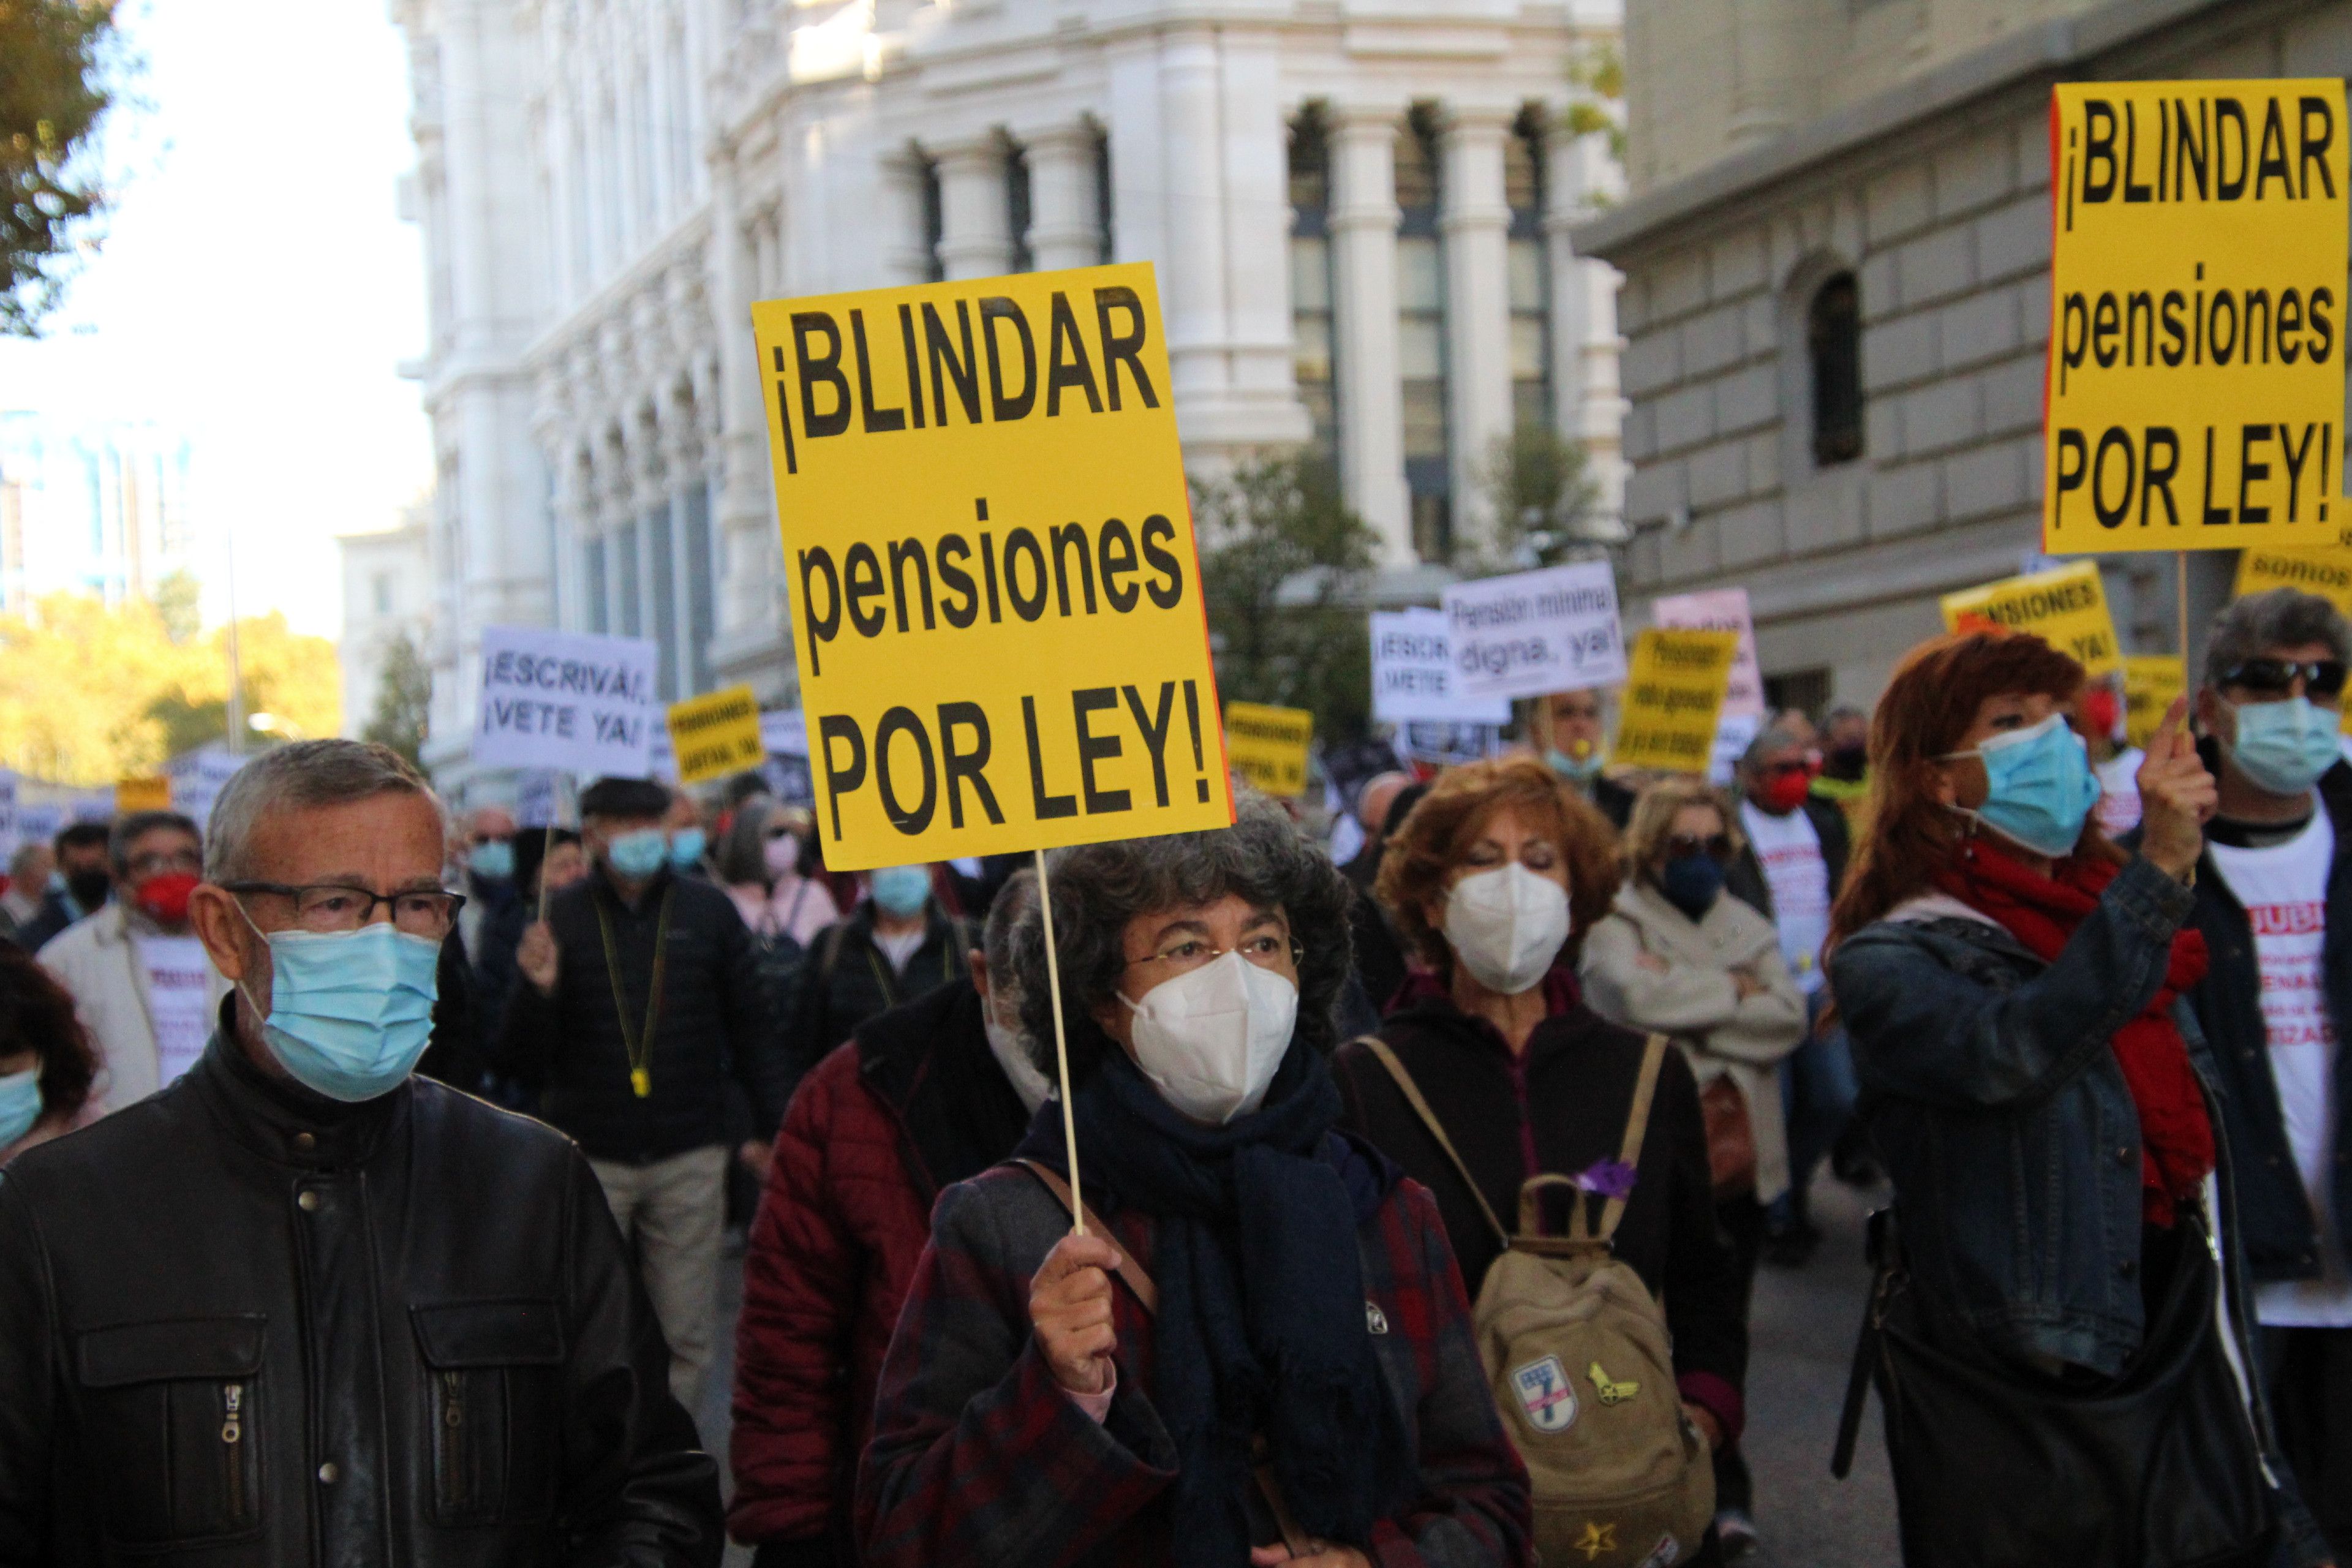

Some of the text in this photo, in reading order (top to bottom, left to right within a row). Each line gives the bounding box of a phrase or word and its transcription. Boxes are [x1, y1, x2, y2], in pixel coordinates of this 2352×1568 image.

[2065, 96, 2337, 232] ¡BLINDAR
[773, 285, 1161, 475] ¡BLINDAR
[2060, 262, 2335, 396] pensiones
[2054, 423, 2332, 530] POR LEY!
[797, 497, 1183, 677] pensiones
[592, 710, 641, 748] YA!
[818, 679, 1211, 842] POR LEY!
